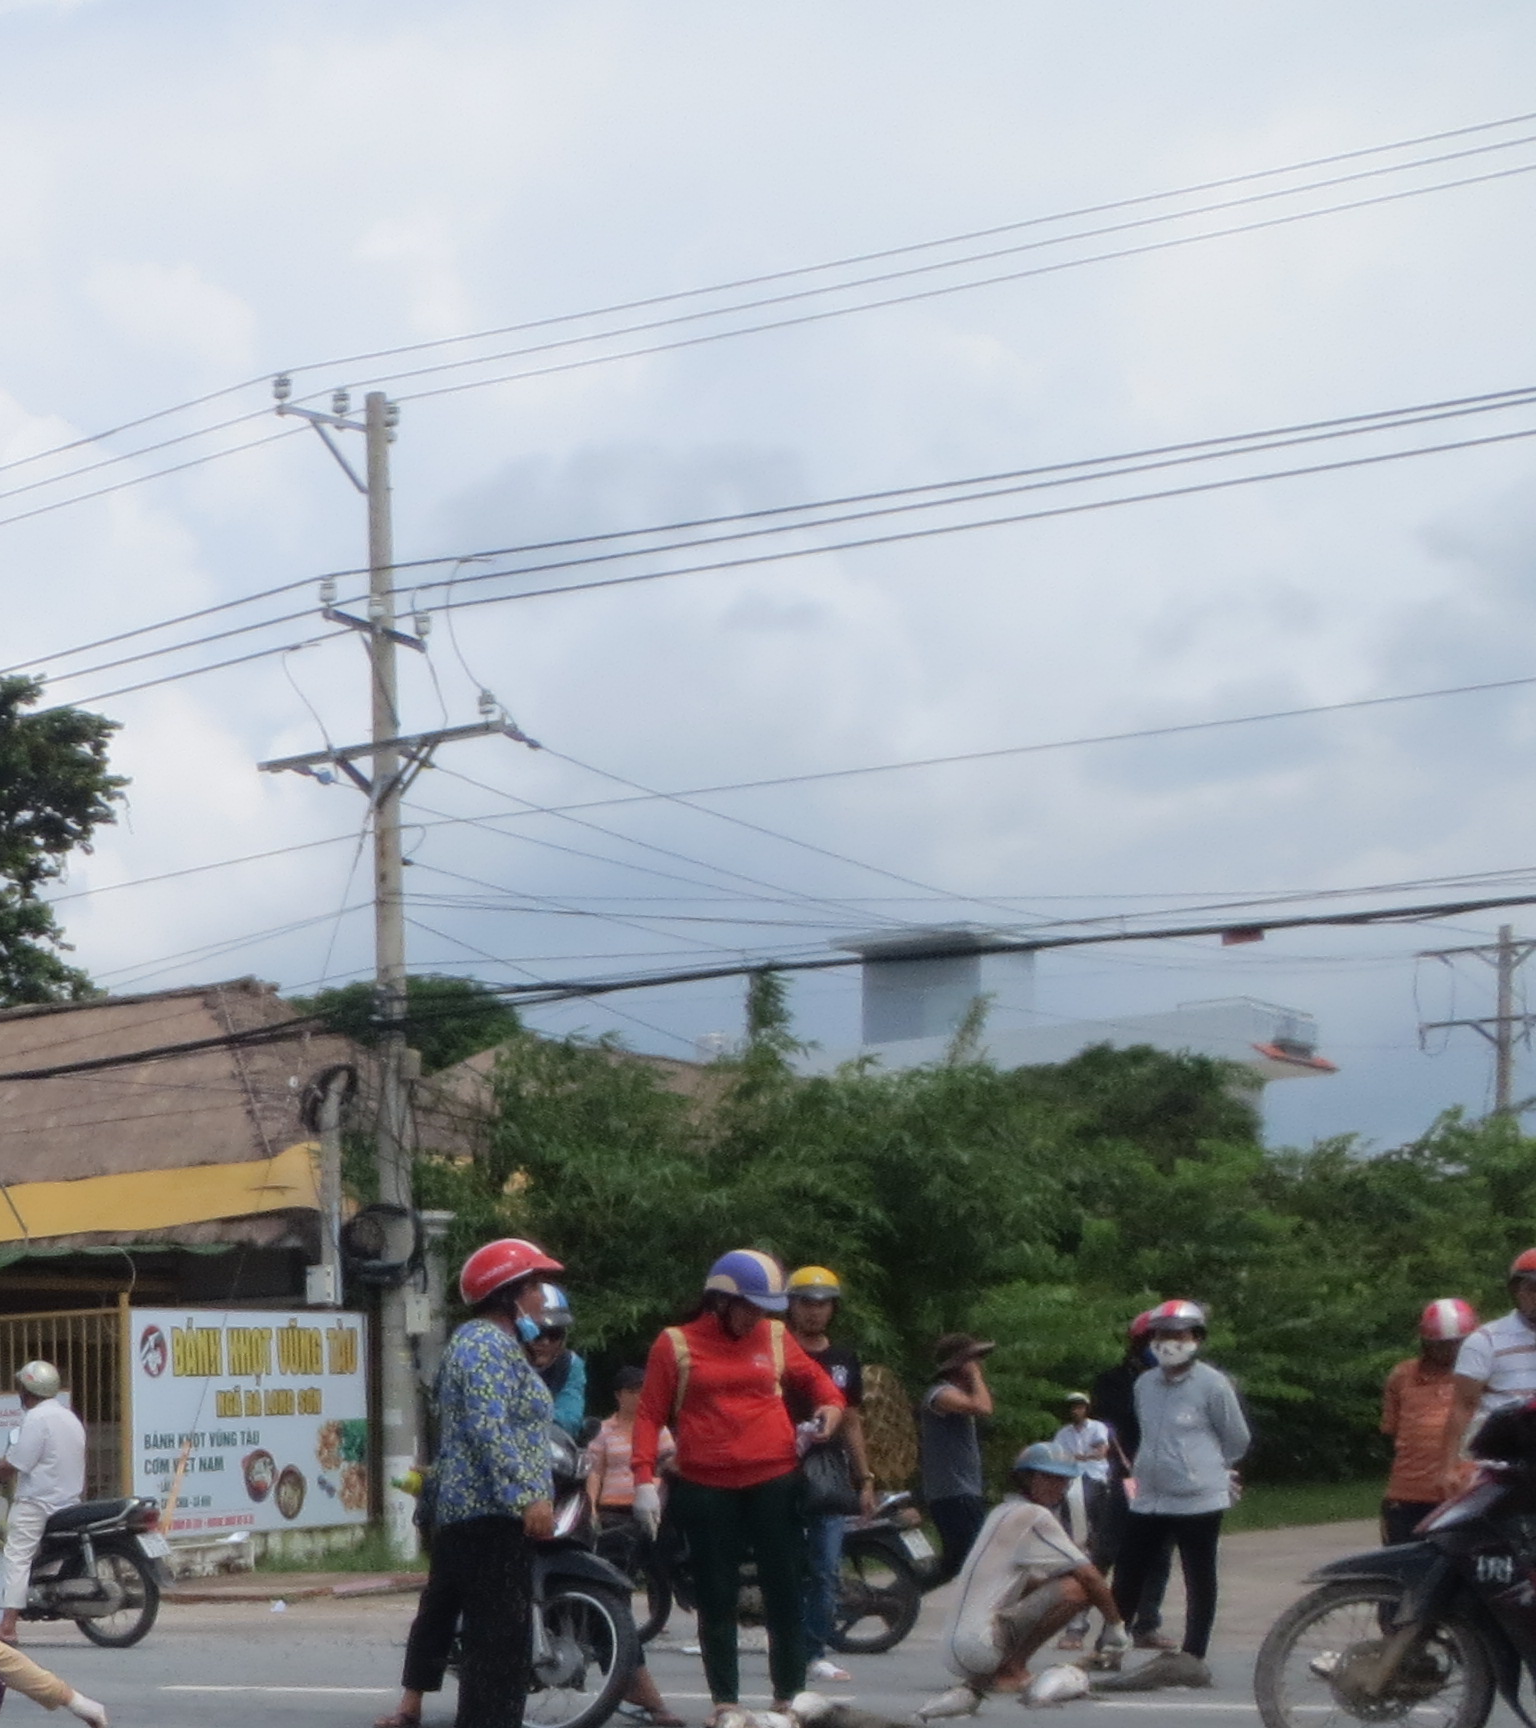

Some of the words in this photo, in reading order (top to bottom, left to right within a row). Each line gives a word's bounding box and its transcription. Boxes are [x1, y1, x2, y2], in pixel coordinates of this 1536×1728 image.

[144, 1430, 176, 1450] BÁNH
[209, 1428, 238, 1448] VŨNG
[240, 1428, 260, 1446] TÀU
[144, 1457, 170, 1475] CƠM
[199, 1456, 225, 1472] NAM
